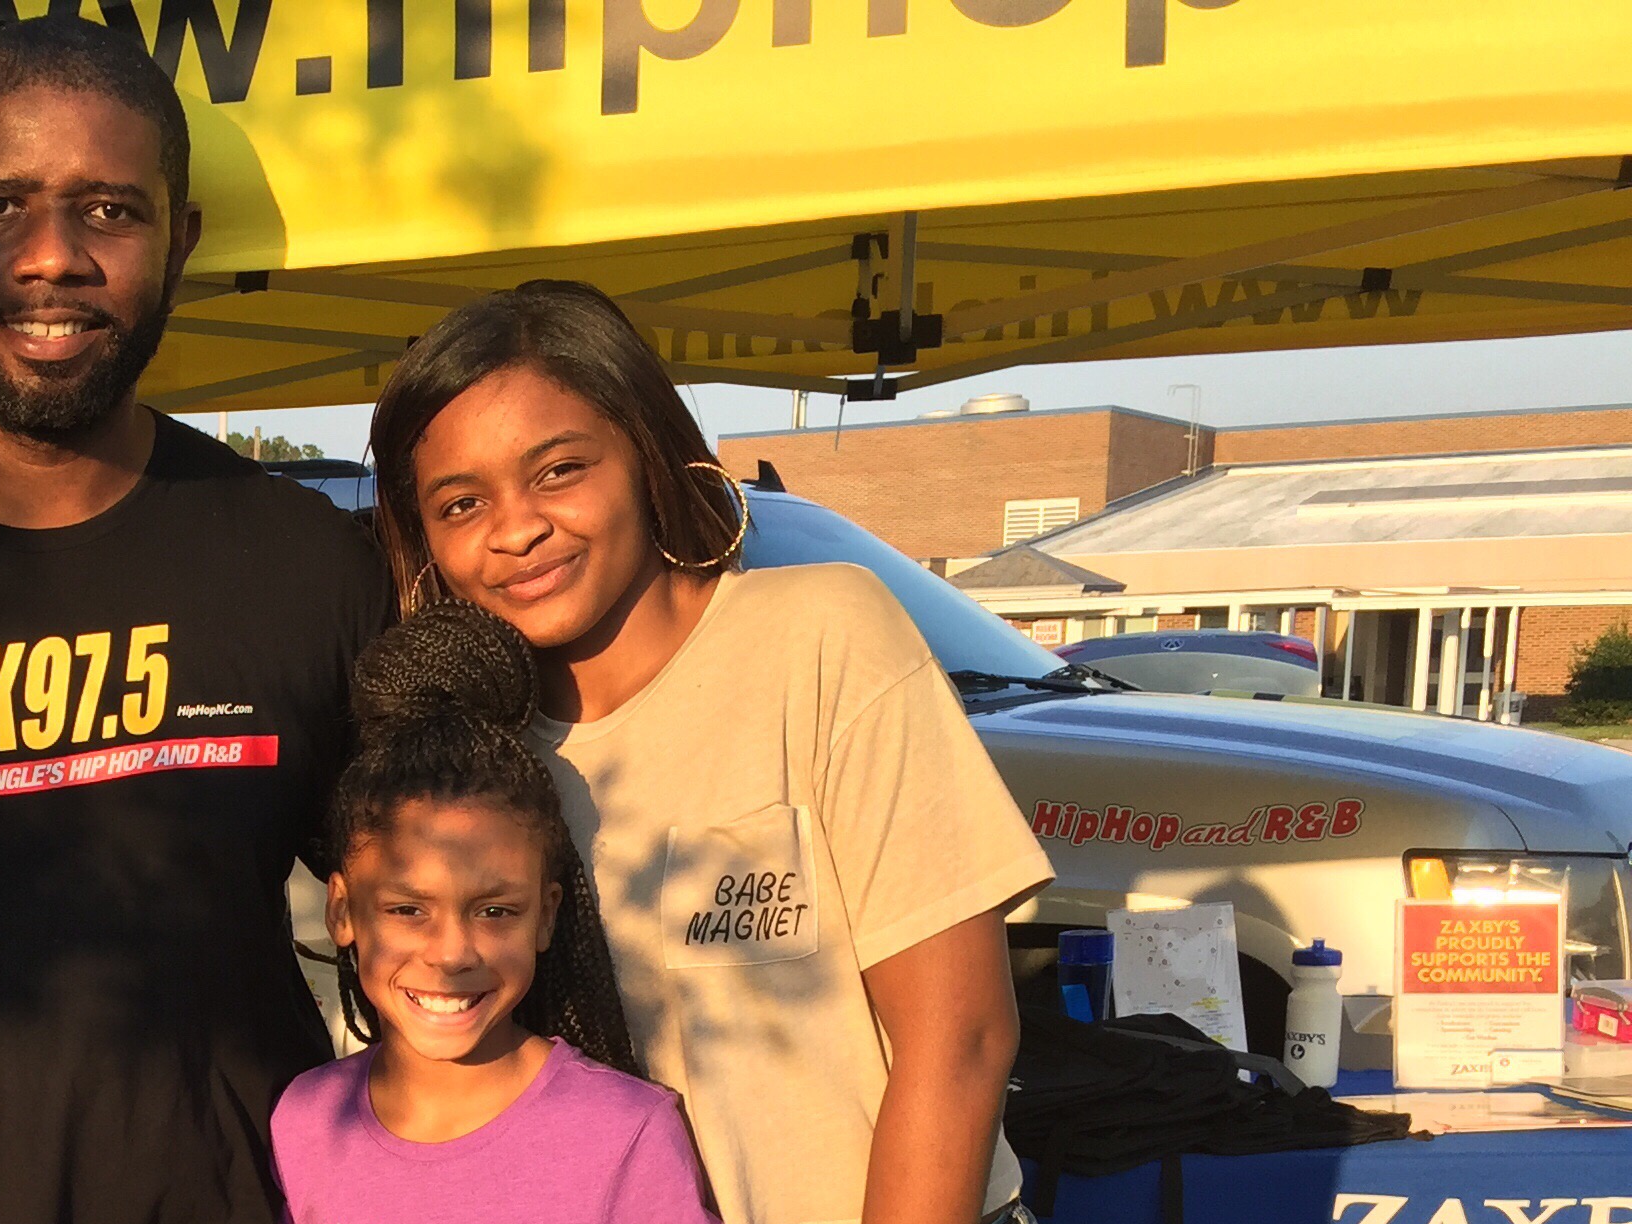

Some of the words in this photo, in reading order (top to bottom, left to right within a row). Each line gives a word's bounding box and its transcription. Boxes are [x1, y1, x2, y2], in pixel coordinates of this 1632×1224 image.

[176, 702, 254, 718] HipHopNC.com
[69, 757, 106, 780] HIP
[109, 750, 154, 776] HOP
[154, 745, 200, 767] AND
[202, 744, 242, 763] R&B
[1260, 797, 1366, 844] R&B
[714, 871, 797, 907] BABE
[684, 903, 809, 946] MAGNET
[1440, 919, 1521, 936] ZAXBY'S
[1435, 936, 1525, 952] PROUDLY
[1410, 952, 1509, 968] SUPPORTS
[1516, 952, 1551, 967] THE
[1417, 967, 1544, 983] COMMUNITY.
